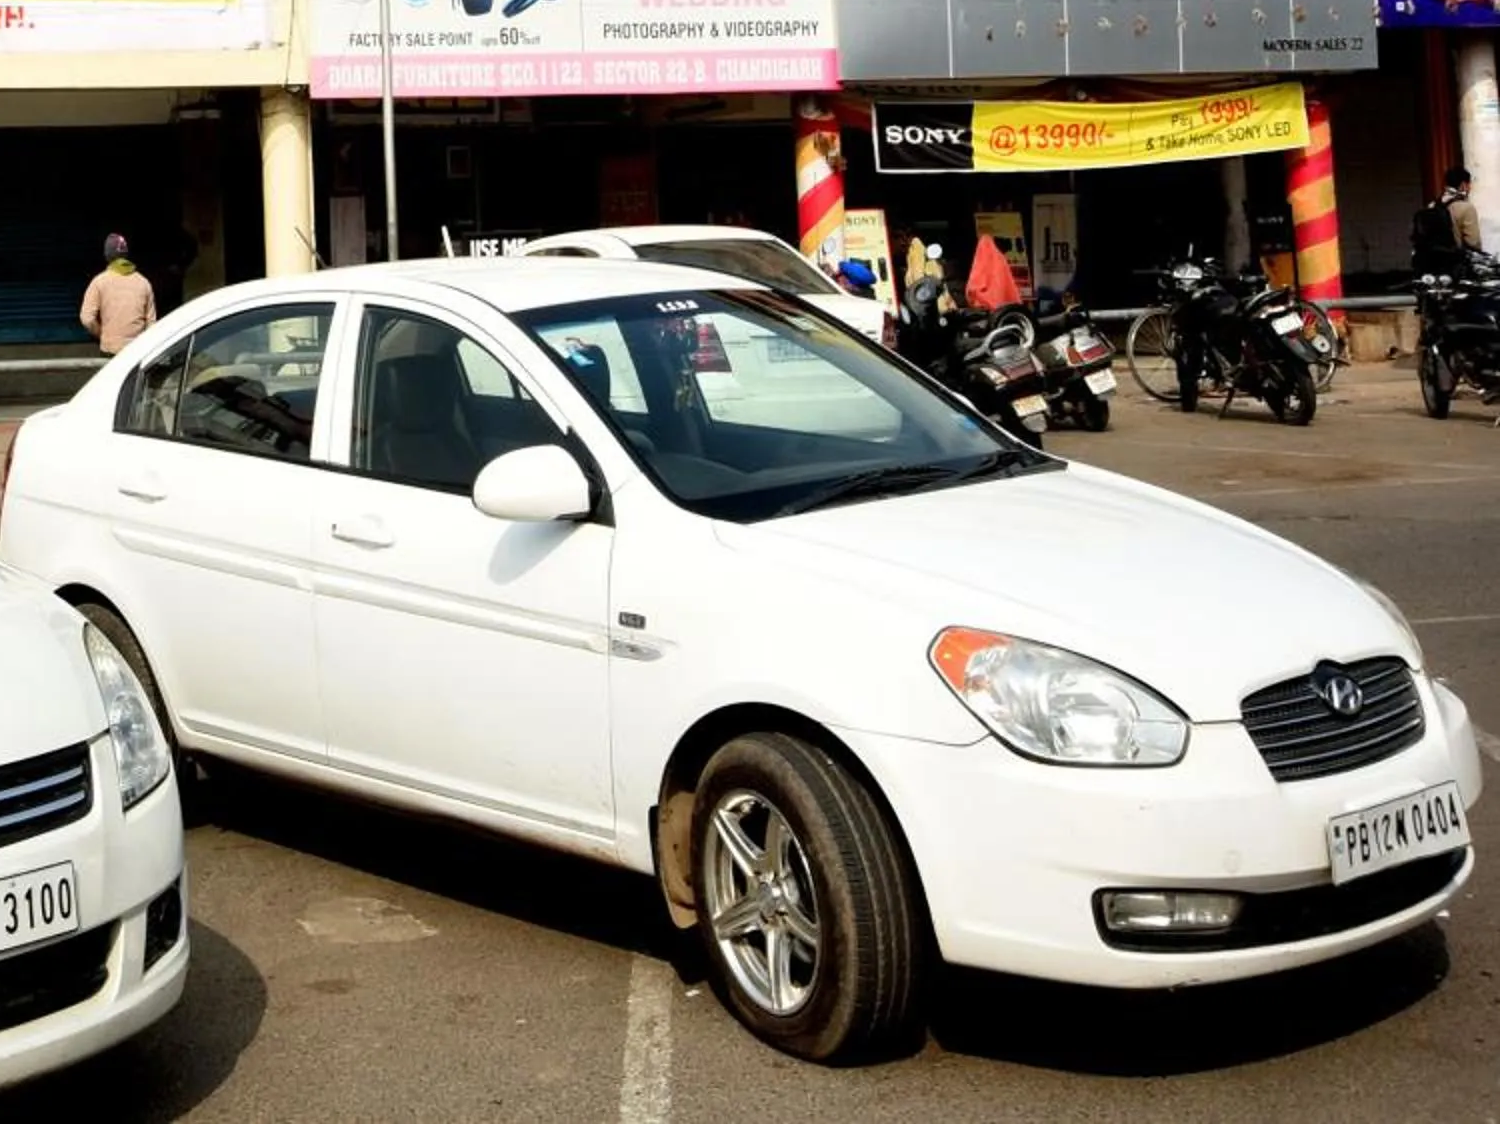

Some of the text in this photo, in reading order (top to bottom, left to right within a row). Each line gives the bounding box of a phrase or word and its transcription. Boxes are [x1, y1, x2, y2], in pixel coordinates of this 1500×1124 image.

[406, 32, 435, 47] SALE
[439, 32, 473, 46] POINT
[603, 21, 819, 39] PHOTOGRAPHY & VIDEOGRAPHY
[1316, 37, 1346, 50] SALES
[393, 62, 495, 89] FURNITURE
[593, 60, 662, 85] SECTOR
[715, 56, 822, 82] CHANDIGARH
[885, 125, 965, 145] SONY
[1227, 126, 1262, 143] SONY
[1267, 121, 1292, 138] LED
[1411, 792, 1461, 842] 0404
[3, 877, 73, 934] 3100
